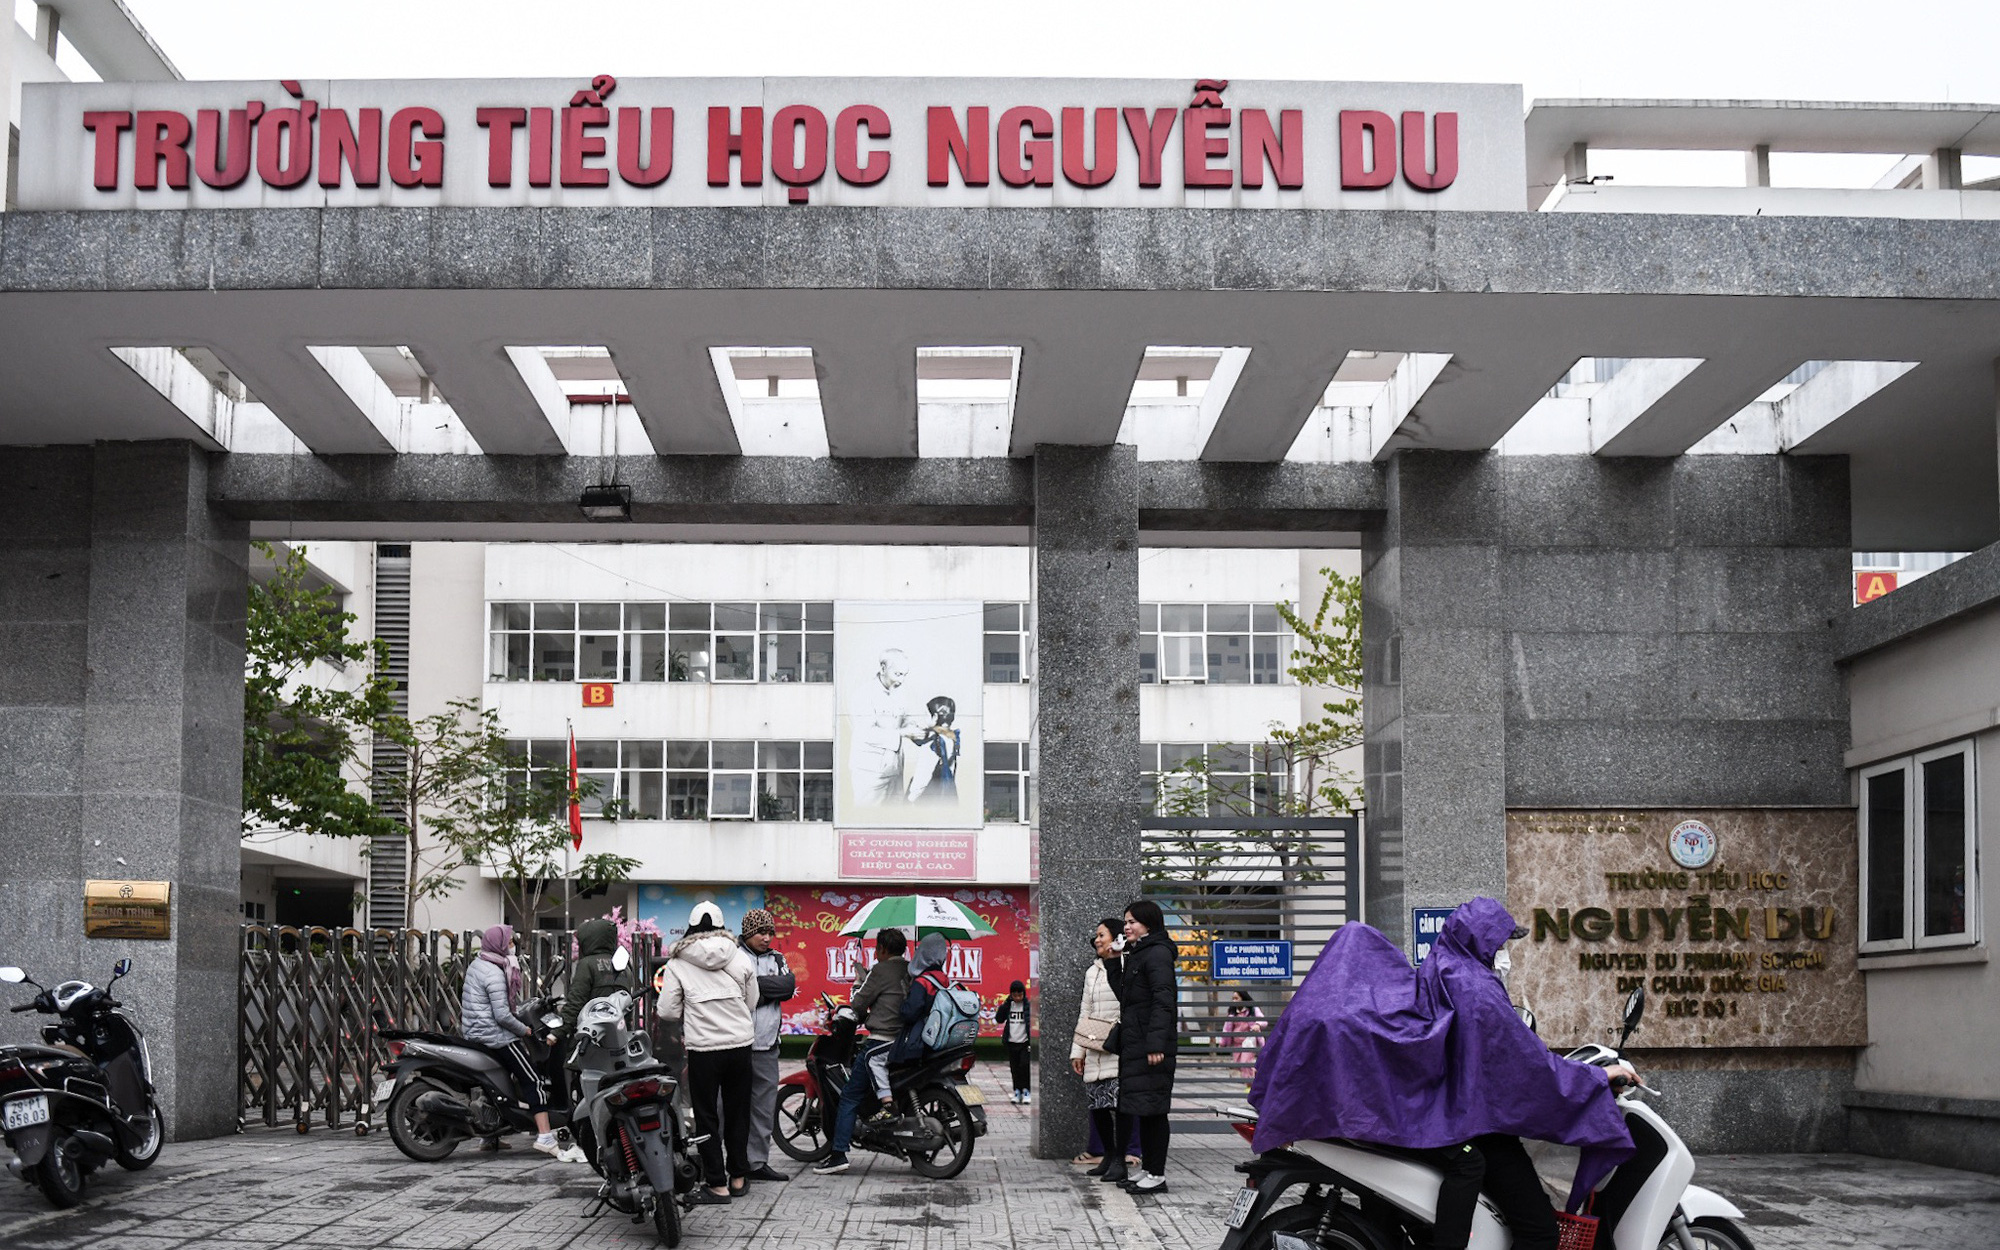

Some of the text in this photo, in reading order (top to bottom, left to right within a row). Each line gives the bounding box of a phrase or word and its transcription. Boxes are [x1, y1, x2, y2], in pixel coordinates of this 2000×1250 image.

[83, 74, 1459, 204] TRƯỜNG TIỂU HỌC NGUYỄN DU
[1866, 576, 1887, 598] A
[590, 686, 605, 704] B
[1605, 866, 1689, 892] TRƯỜNG
[1534, 894, 1835, 942] NGUYỄN DU
[1655, 952, 1677, 971] DU
[1758, 975, 1787, 993] GIA
[9, 1108, 46, 1128] 958.03
